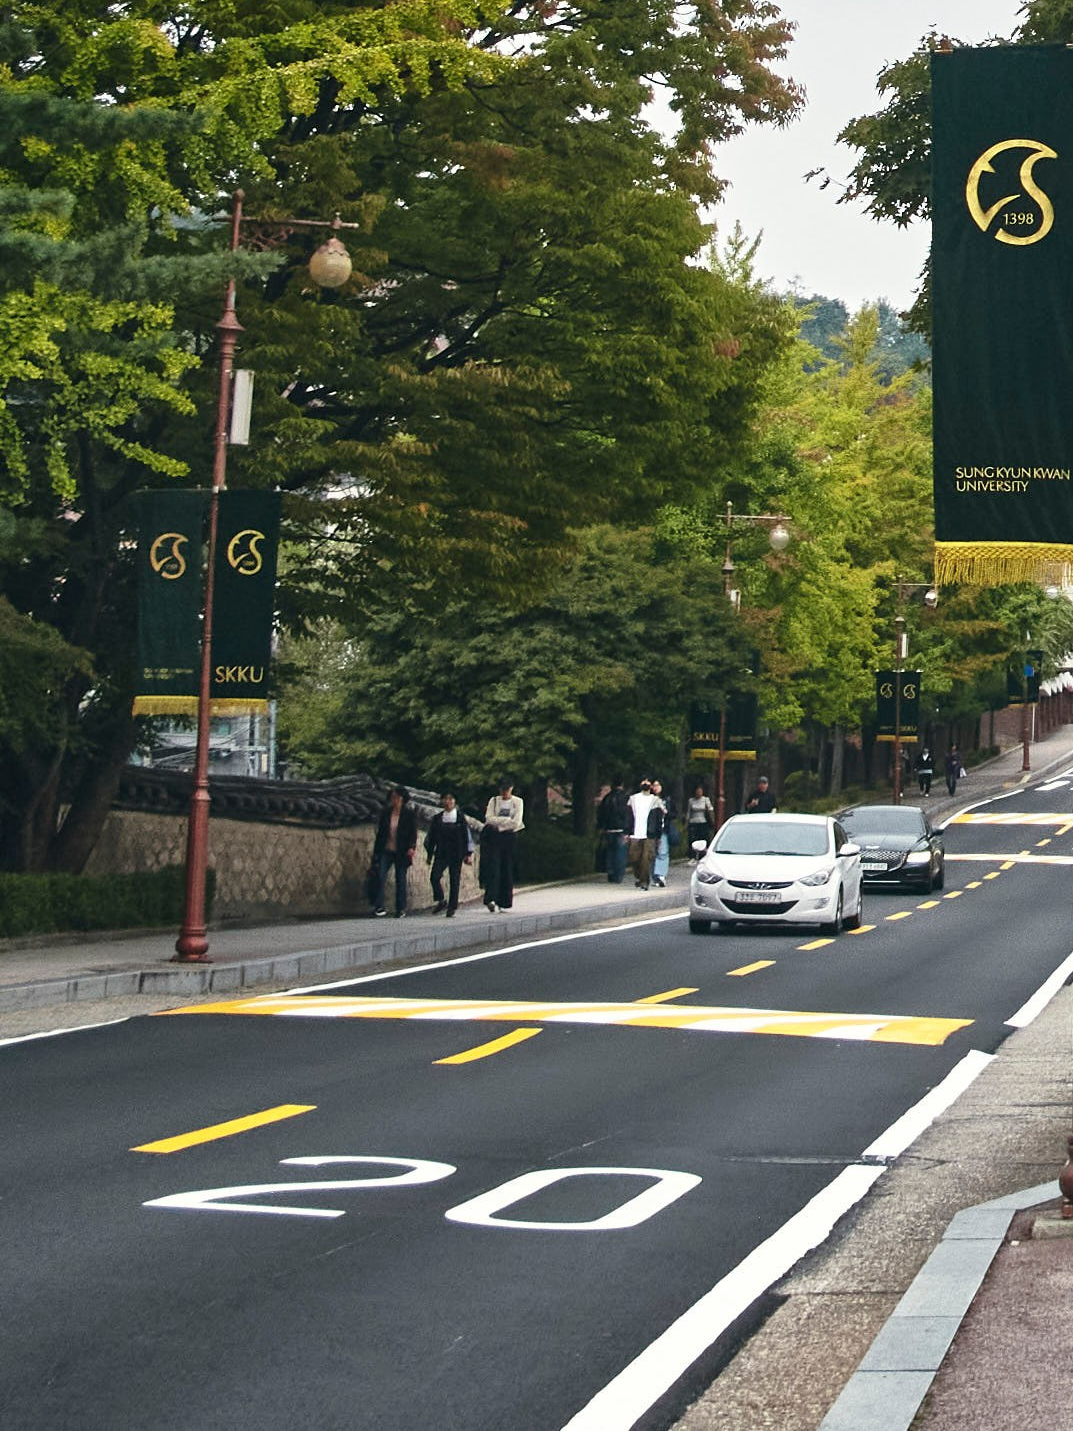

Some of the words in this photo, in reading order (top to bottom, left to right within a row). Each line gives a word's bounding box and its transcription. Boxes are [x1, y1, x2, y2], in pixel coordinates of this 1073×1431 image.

[1003, 212, 1034, 226] 1398
[956, 480, 1029, 492] UNIVERSITY
[214, 665, 264, 683] SKKU
[140, 1155, 703, 1231] 20
